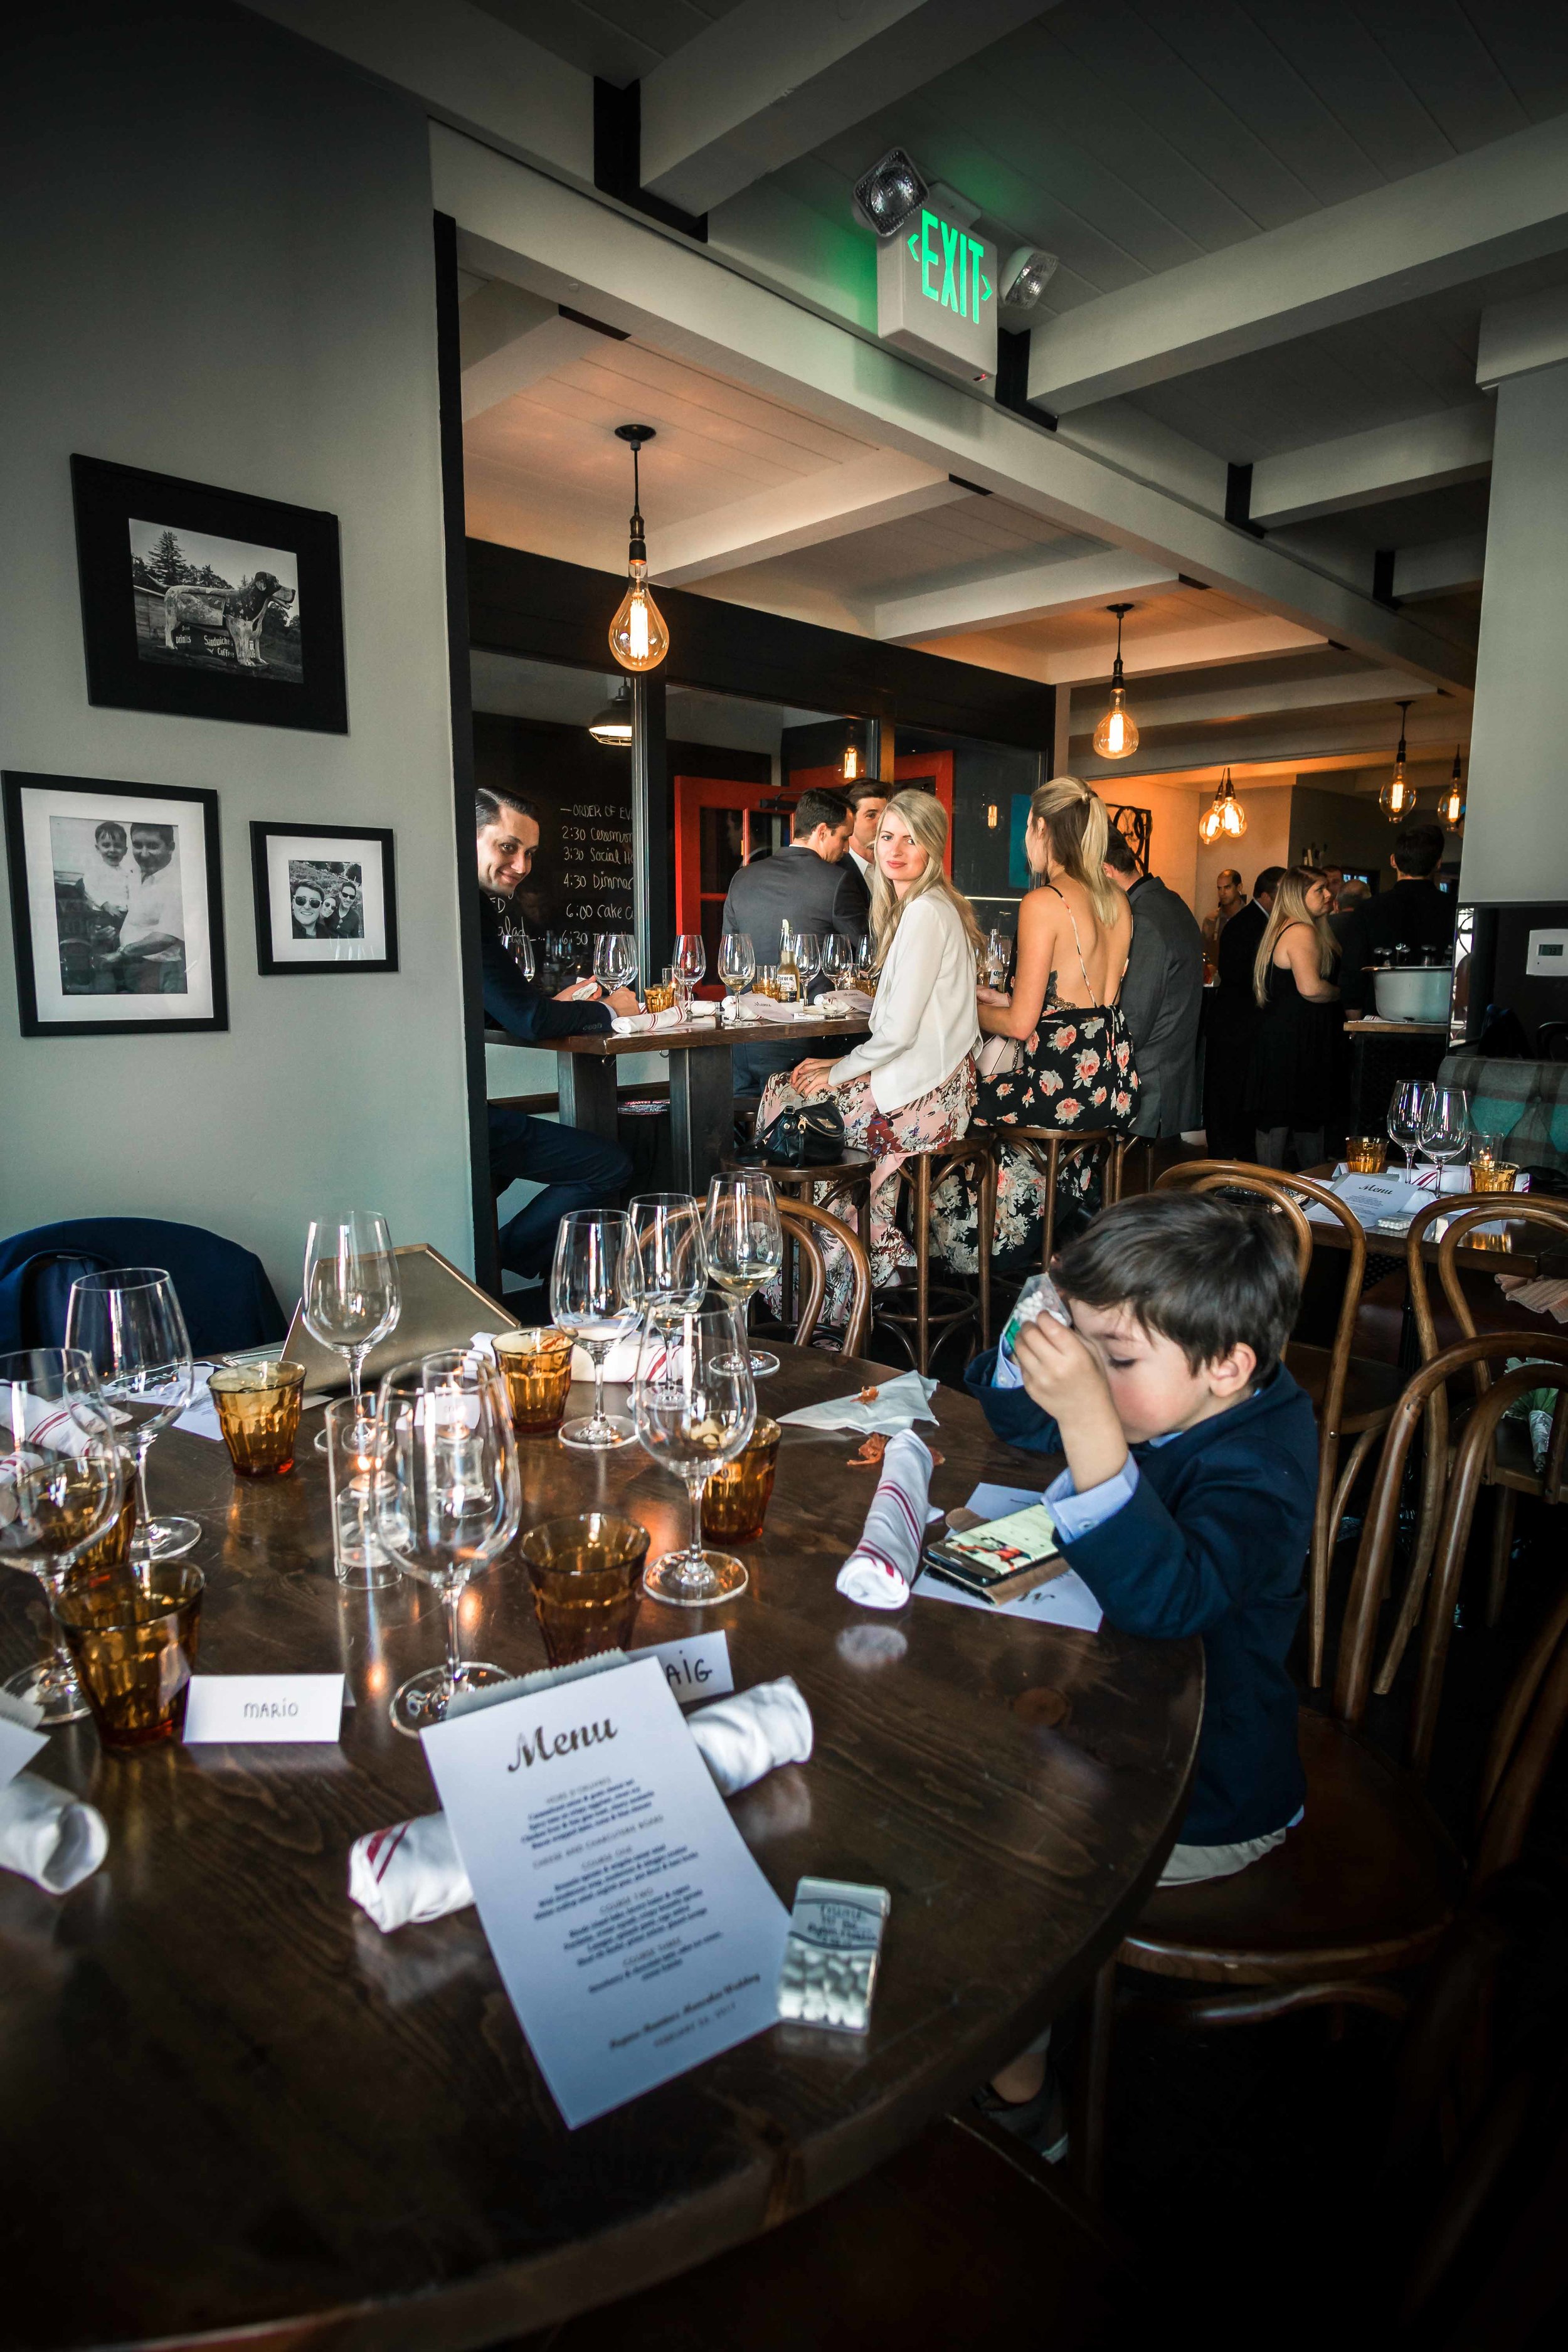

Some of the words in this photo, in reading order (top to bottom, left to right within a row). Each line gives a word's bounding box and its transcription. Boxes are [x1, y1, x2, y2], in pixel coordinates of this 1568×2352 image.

[921, 208, 984, 324] EXIT
[204, 635, 234, 647] Sandwiche
[573, 804, 601, 817] ORDER
[605, 805, 616, 817] OF
[620, 807, 633, 819] EV
[562, 826, 586, 840] 2:30
[563, 847, 584, 861] 3:30
[591, 847, 621, 865] Social
[564, 872, 586, 889] 4:30
[566, 903, 593, 920] 6:00
[597, 903, 622, 919] Cake
[561, 930, 588, 946] 6:30
[1359, 1184, 1393, 1194] Menu
[507, 1718, 618, 1772] Menu
